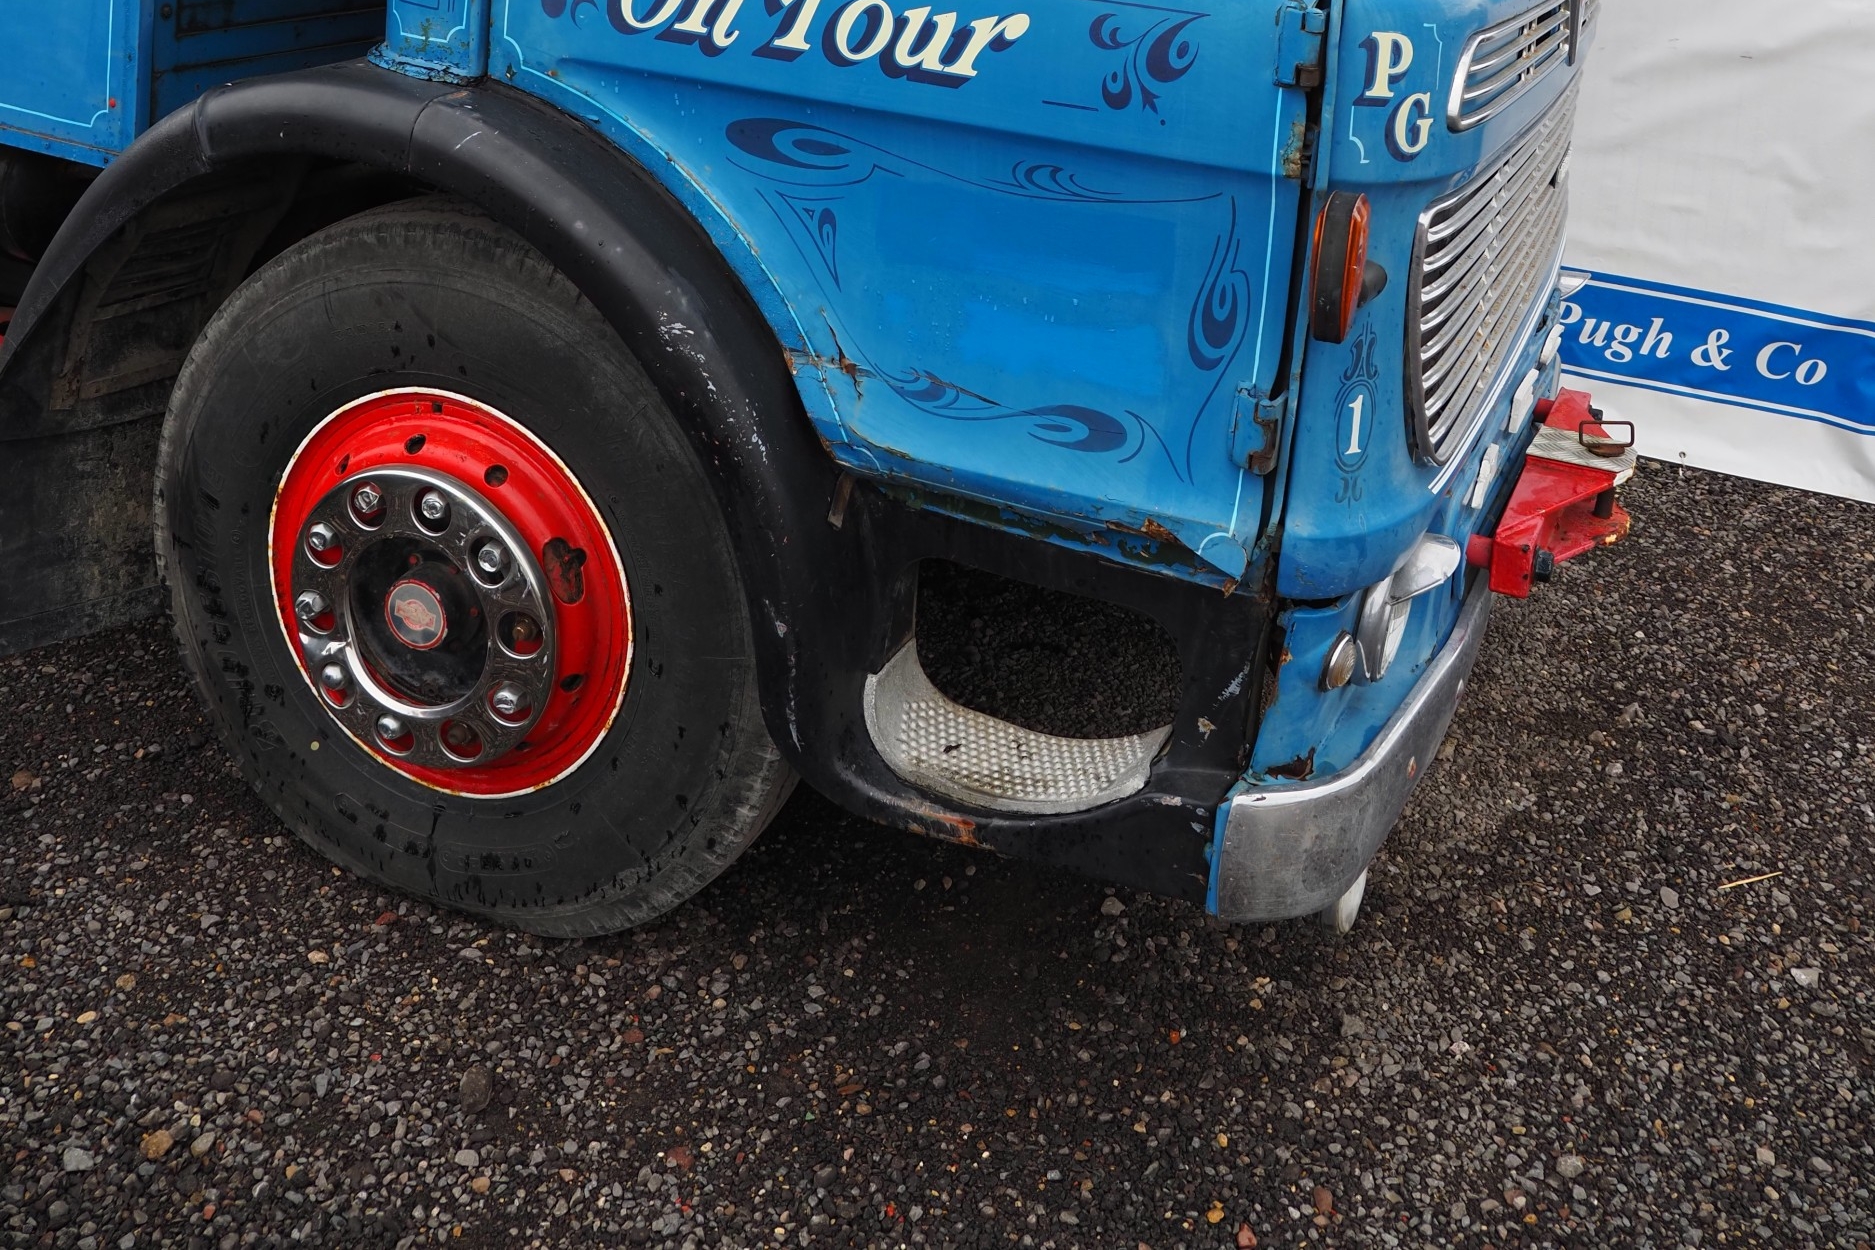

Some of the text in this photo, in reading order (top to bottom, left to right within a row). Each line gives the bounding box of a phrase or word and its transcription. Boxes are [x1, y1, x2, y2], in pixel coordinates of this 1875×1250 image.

[1690, 328, 1734, 371] &
[1755, 341, 1828, 386] Co
[1344, 394, 1364, 455] 1
